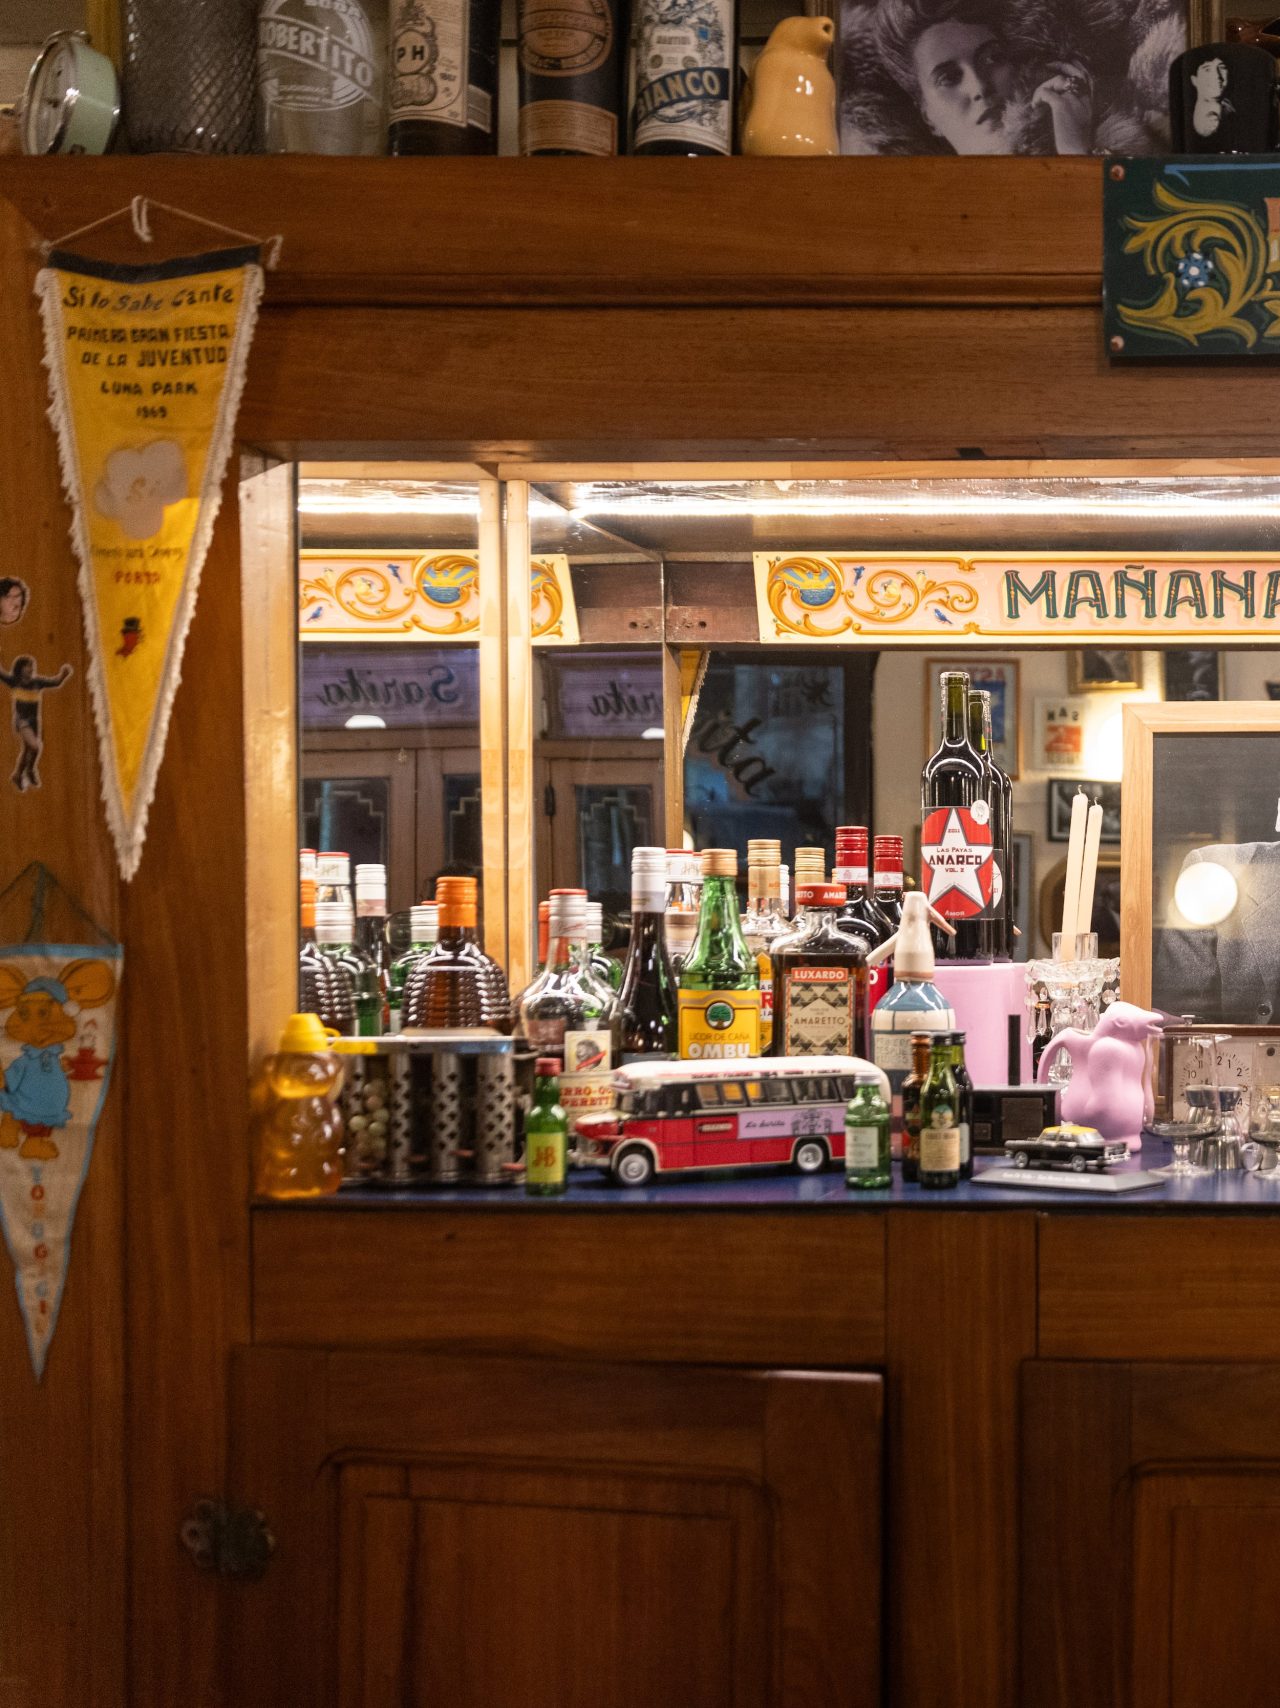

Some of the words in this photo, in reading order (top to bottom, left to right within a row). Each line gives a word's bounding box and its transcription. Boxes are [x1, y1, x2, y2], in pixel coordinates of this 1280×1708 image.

[63, 285, 86, 307] Si
[174, 324, 231, 342] FIESTA
[81, 352, 101, 365] DE
[107, 353, 127, 366] LA
[137, 346, 228, 367] JUVENTUD
[152, 381, 198, 395] PARK
[928, 855, 983, 866] ANARCO
[794, 970, 845, 980] LUXARDO
[794, 1016, 846, 1025] AMARETTO
[688, 1043, 750, 1058] OMBU
